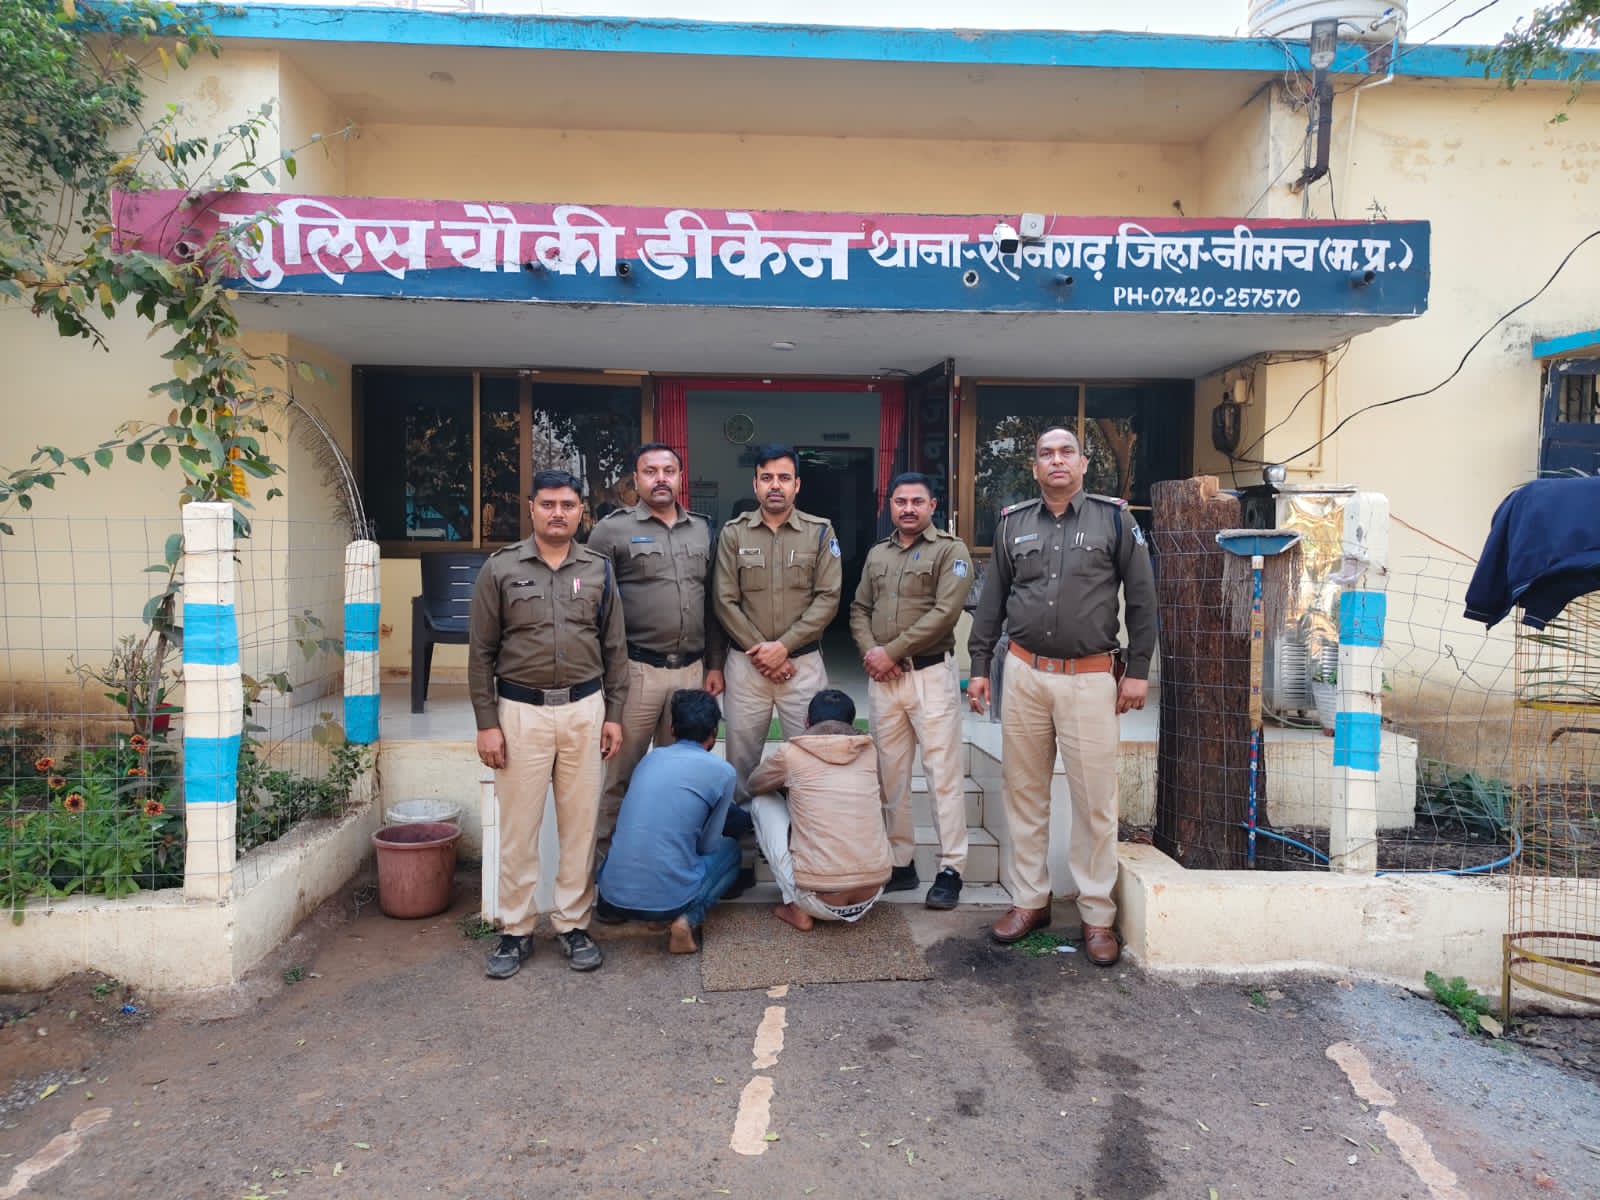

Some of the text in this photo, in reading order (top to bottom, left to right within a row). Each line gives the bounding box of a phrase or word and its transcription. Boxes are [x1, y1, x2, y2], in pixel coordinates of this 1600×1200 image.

[440, 204, 625, 277] चौकी
[637, 209, 864, 280] डीकेन
[1113, 286, 1301, 308] PH-07420-257570
